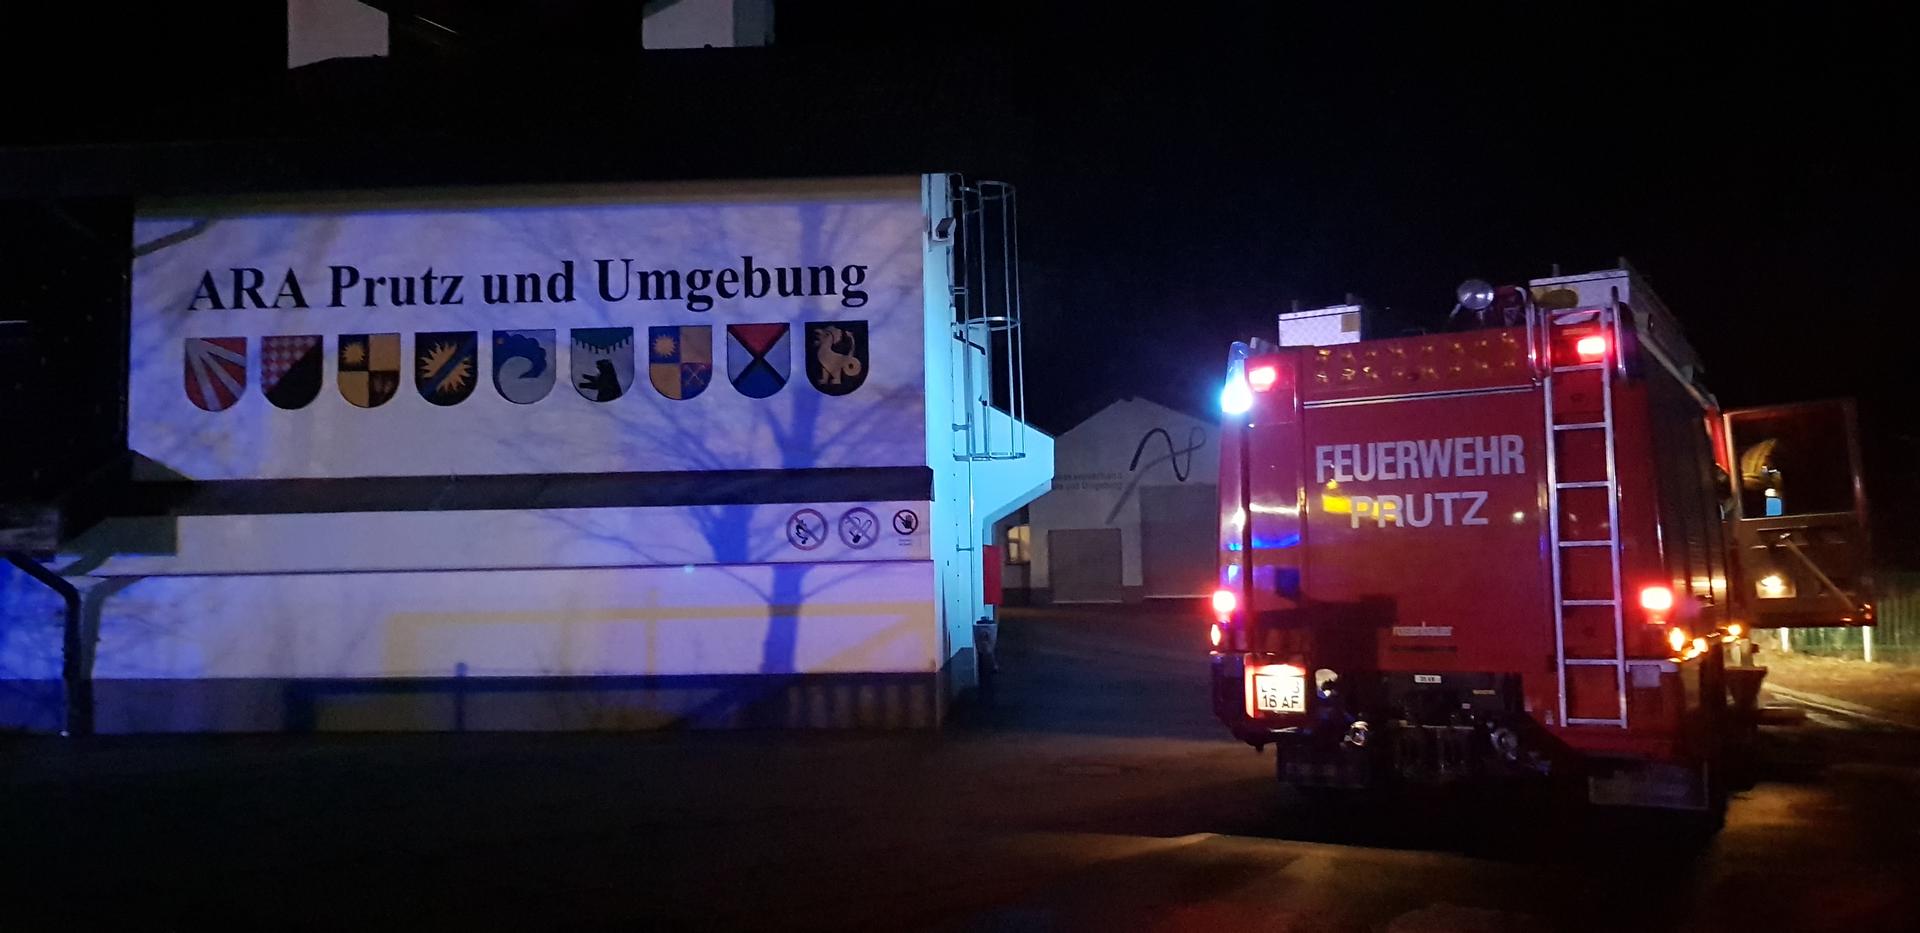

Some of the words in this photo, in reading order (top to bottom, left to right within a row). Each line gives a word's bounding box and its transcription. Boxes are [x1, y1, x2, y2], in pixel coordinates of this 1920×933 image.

[187, 266, 310, 311] ARA
[326, 265, 465, 308] Prutz
[480, 260, 577, 304] und
[593, 256, 869, 312] Umgebung
[1316, 434, 1527, 484] FEUERWEHR
[1351, 491, 1489, 529] PRUTZ
